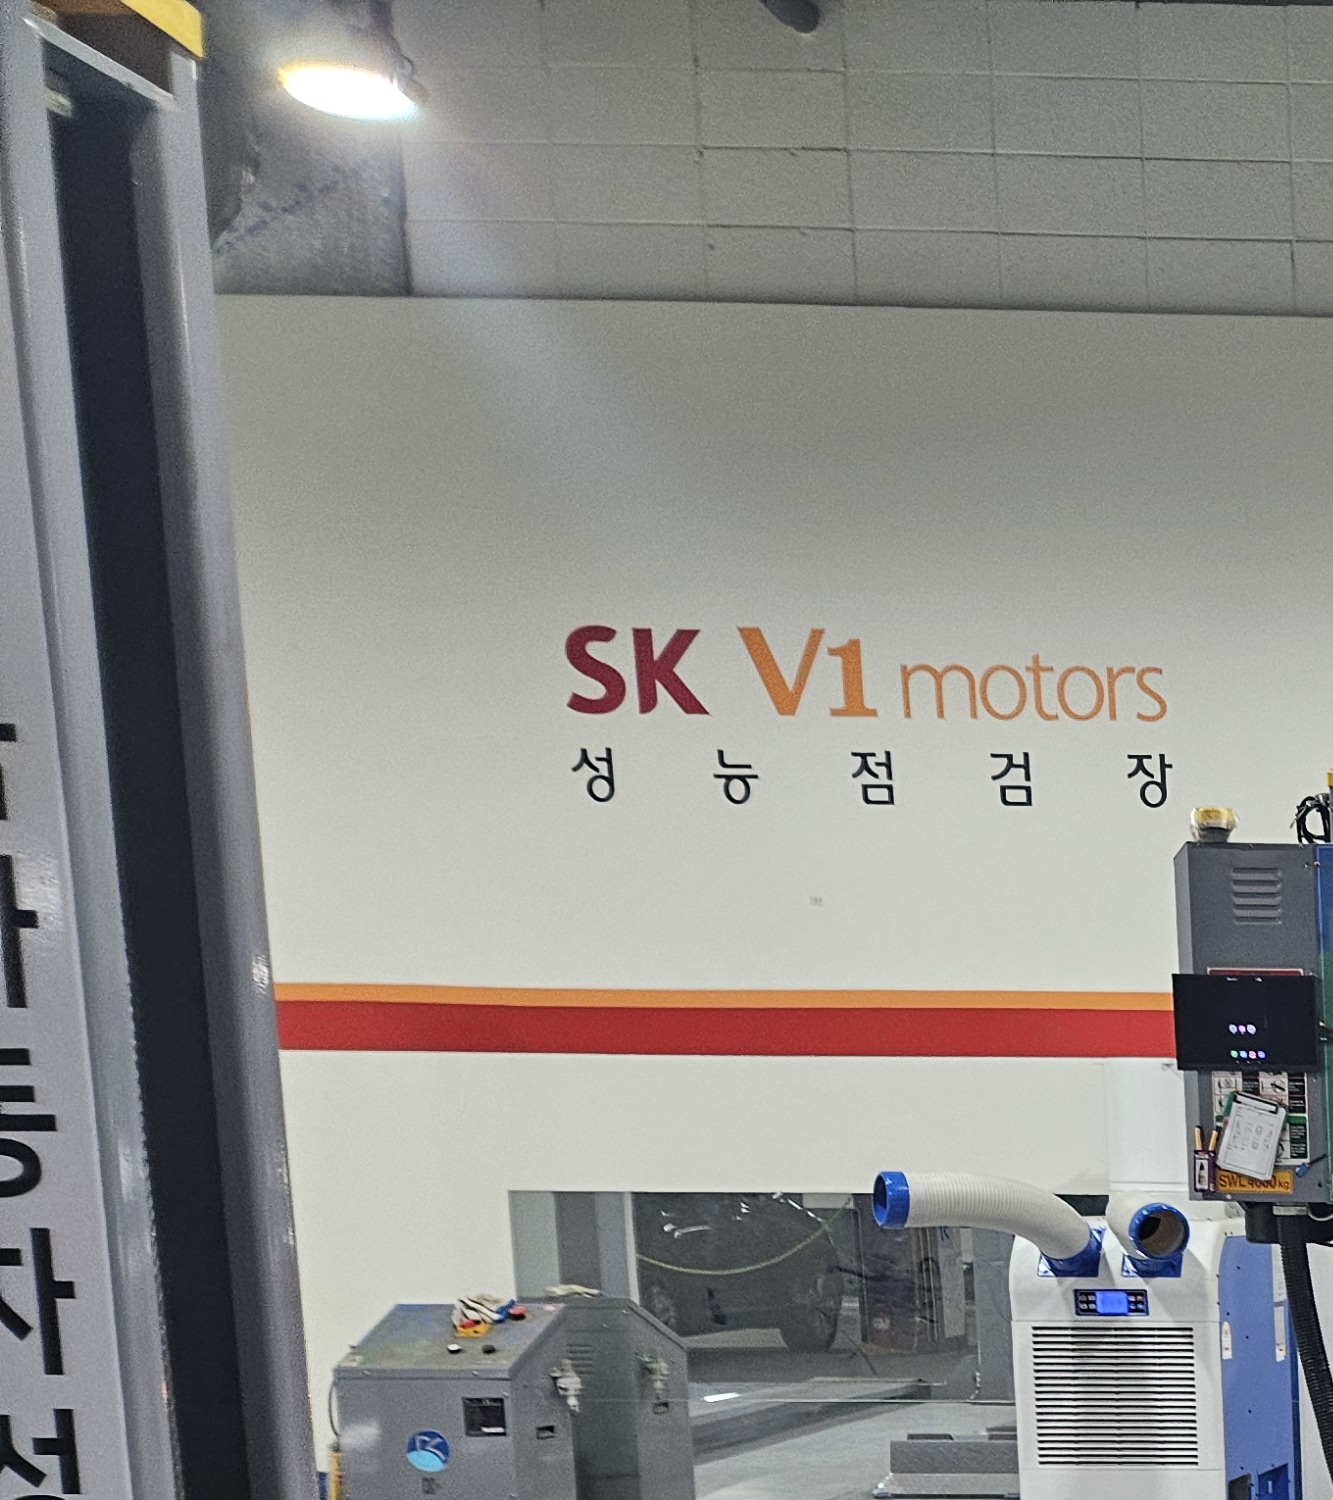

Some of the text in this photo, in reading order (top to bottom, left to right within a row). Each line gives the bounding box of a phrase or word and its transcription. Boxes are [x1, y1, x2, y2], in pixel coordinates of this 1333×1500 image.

[565, 624, 1168, 722] SK V1 motors
[1219, 1174, 1247, 1188] SWL
